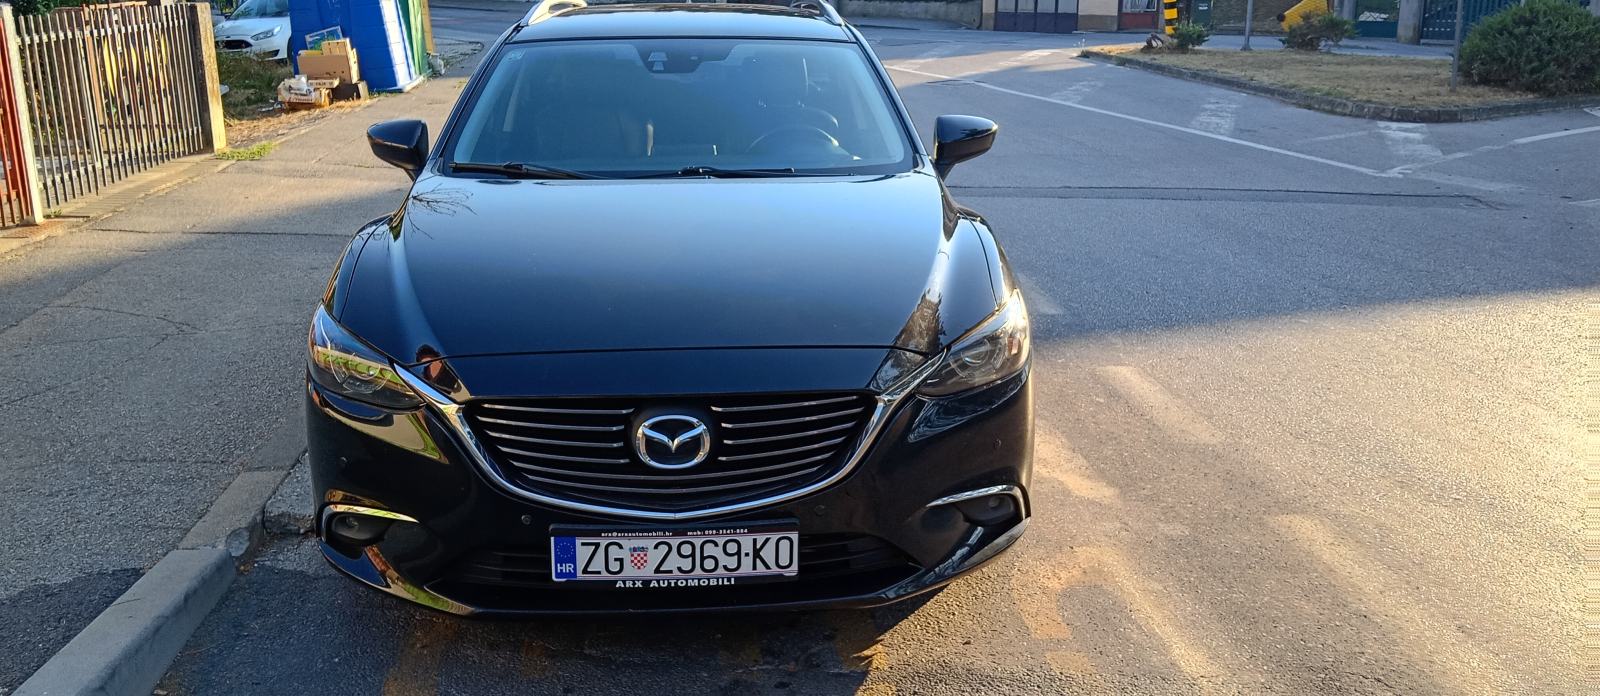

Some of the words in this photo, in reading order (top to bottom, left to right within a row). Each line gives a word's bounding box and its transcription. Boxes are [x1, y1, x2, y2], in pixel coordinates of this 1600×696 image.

[580, 541, 625, 575] ZG
[557, 562, 574, 573] HR
[615, 579, 643, 588] ARX
[650, 577, 735, 588] AUTOMOBILI
